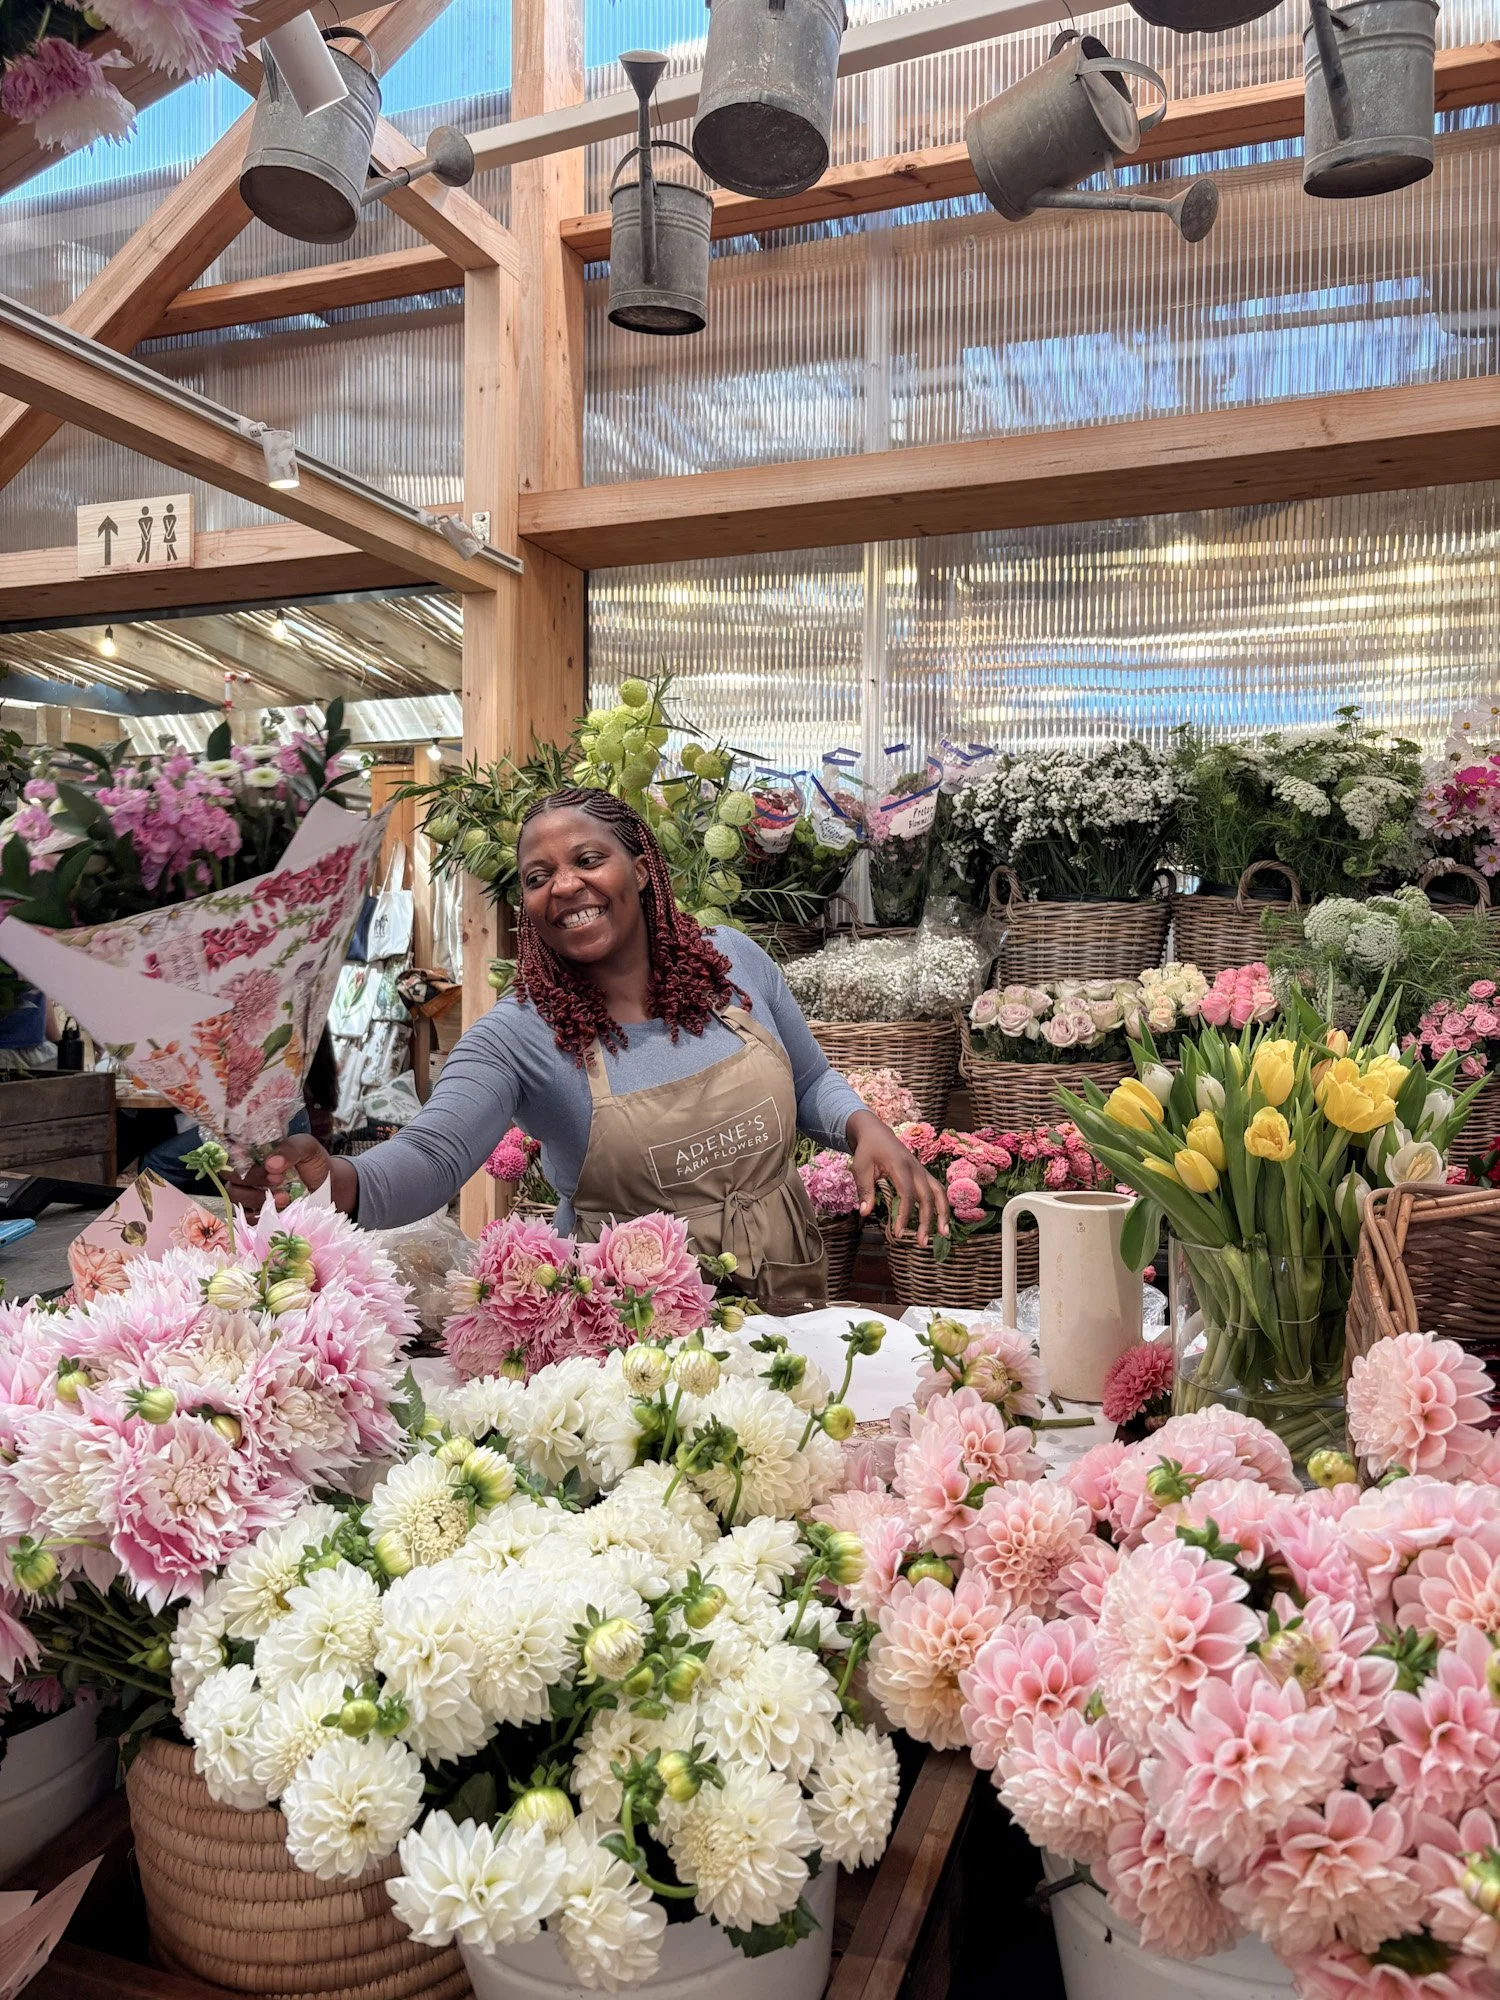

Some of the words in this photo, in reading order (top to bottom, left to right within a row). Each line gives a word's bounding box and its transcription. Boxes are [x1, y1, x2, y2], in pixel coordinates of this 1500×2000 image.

[675, 1114, 766, 1166] ADENE'S
[676, 1156, 710, 1177] FARM
[713, 1132, 769, 1160] FLOWERS
